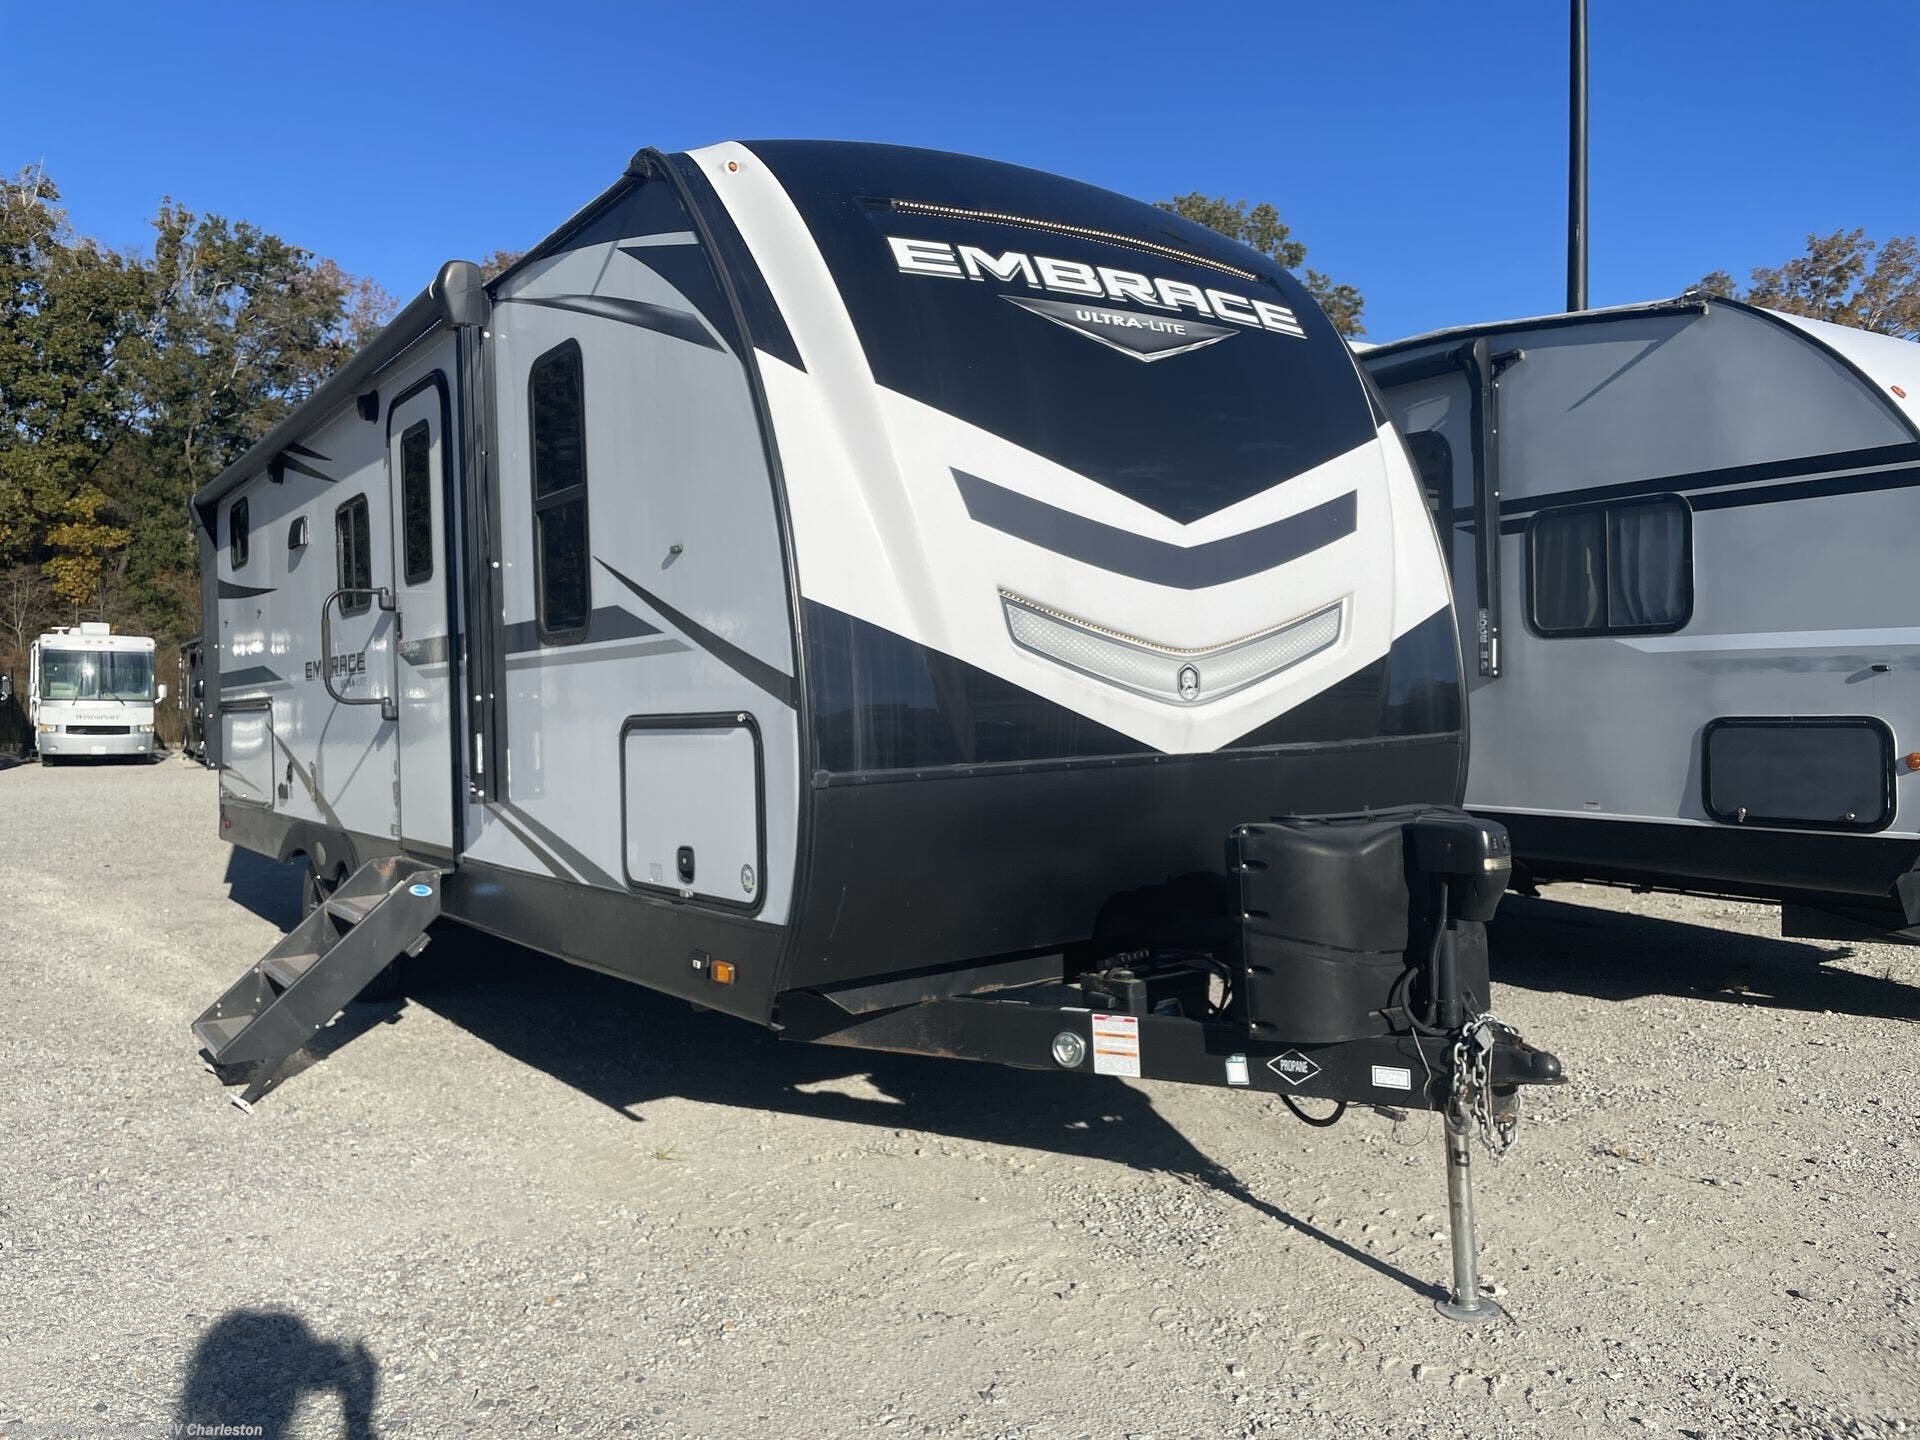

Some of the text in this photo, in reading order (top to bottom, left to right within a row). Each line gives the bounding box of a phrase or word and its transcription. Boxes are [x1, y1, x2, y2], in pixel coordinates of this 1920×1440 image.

[887, 236, 1308, 339] EMBRACE
[1076, 310, 1186, 335] ULTRA-LITE
[305, 652, 366, 681] EMRACE
[1280, 1059, 1308, 1073] PROPANE
